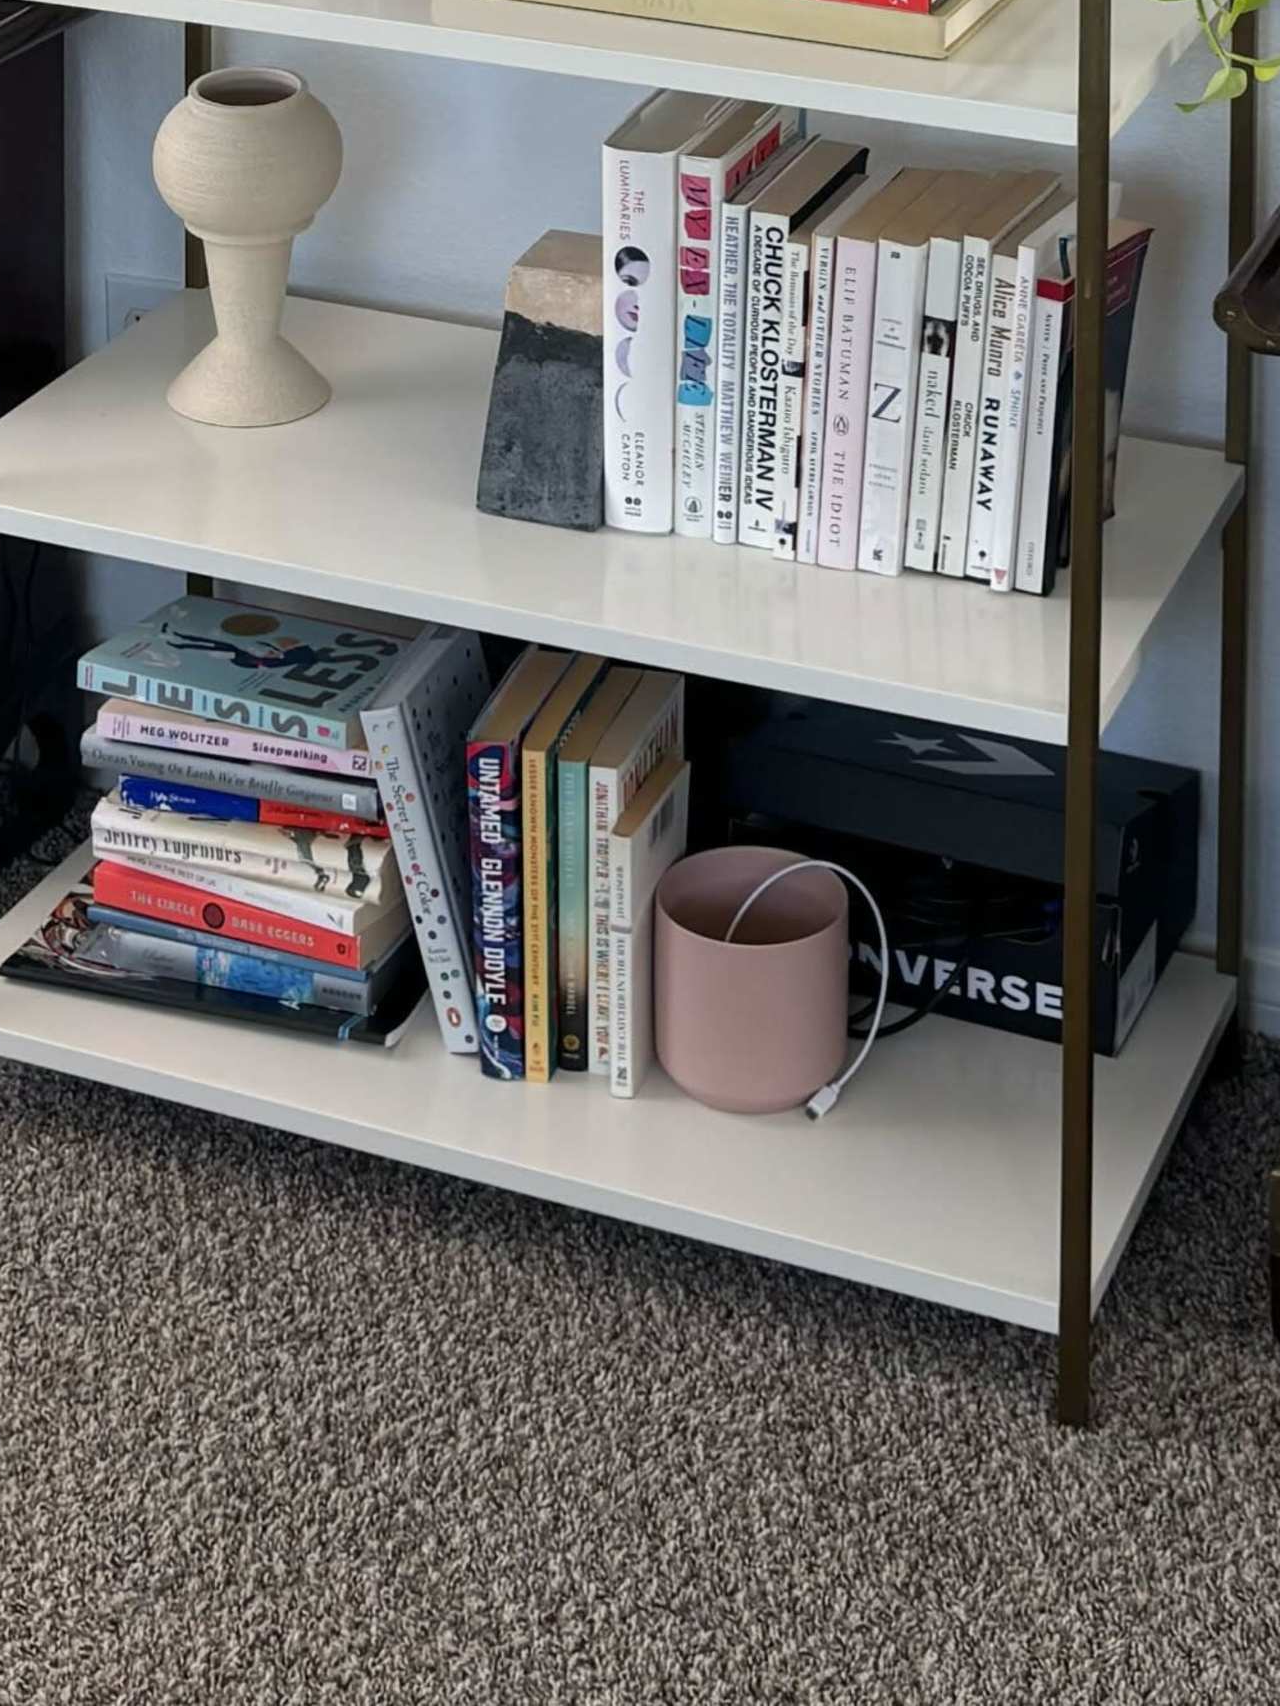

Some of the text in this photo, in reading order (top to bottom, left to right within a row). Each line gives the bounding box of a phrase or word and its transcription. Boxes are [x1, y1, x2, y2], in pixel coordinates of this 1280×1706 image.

[619, 159, 631, 242] LUMINARIES
[634, 189, 645, 214] THE
[752, 234, 762, 275] DECADE
[817, 247, 829, 290] VIRGIN
[751, 278, 760, 293] OF
[960, 254, 974, 326] COCOA PUFFS
[750, 296, 760, 341] CURIOUS
[814, 316, 826, 358] OTHER
[971, 319, 981, 342] AND
[987, 278, 1016, 377] Alice Munro
[748, 343, 759, 384] PEOPLE
[754, 226, 784, 511] CHUCK KLOSTERMAN IV
[1008, 276, 1029, 428] ANNE SPHINX
[717, 283, 738, 502] THE TOTALITY MATTHEW WEINER
[747, 386, 757, 407] AND
[783, 386, 797, 424] Kazuo
[810, 363, 823, 416] STORIES
[828, 267, 857, 548] ELIF BATUMAN THE IDIOT
[871, 382, 902, 424] Z
[924, 370, 942, 417] naked
[695, 412, 706, 472] STEPHEN
[744, 410, 756, 473] DANGEROUS
[949, 400, 961, 470] KLOSTERMAN
[963, 402, 974, 438] CHUCK
[620, 433, 631, 483] CATTON
[634, 432, 645, 487] ELEANOR
[778, 427, 794, 475] Ishiguro
[976, 397, 1001, 512] RUNAWAY
[744, 474, 754, 504] IDEAS
[258, 632, 399, 708] LESS
[91, 749, 128, 767] Ocean
[128, 754, 165, 774] Vuong
[186, 765, 215, 781] Earth
[140, 724, 166, 737] MEG
[168, 728, 230, 747] WOLITZER
[252, 742, 328, 765] Sleepwalking
[386, 757, 401, 782] The
[391, 782, 410, 826] Secret
[595, 780, 610, 831] JONATHAN
[403, 828, 418, 862] Lives
[478, 757, 506, 1005] UNTAMED GLENNON DOYLE
[131, 890, 153, 906] THE
[155, 896, 196, 918] CIRCLE
[231, 916, 263, 934] DAVE
[266, 924, 316, 948] EGGERS
[596, 913, 610, 934] THIS
[848, 941, 1064, 1020] NVERSE
